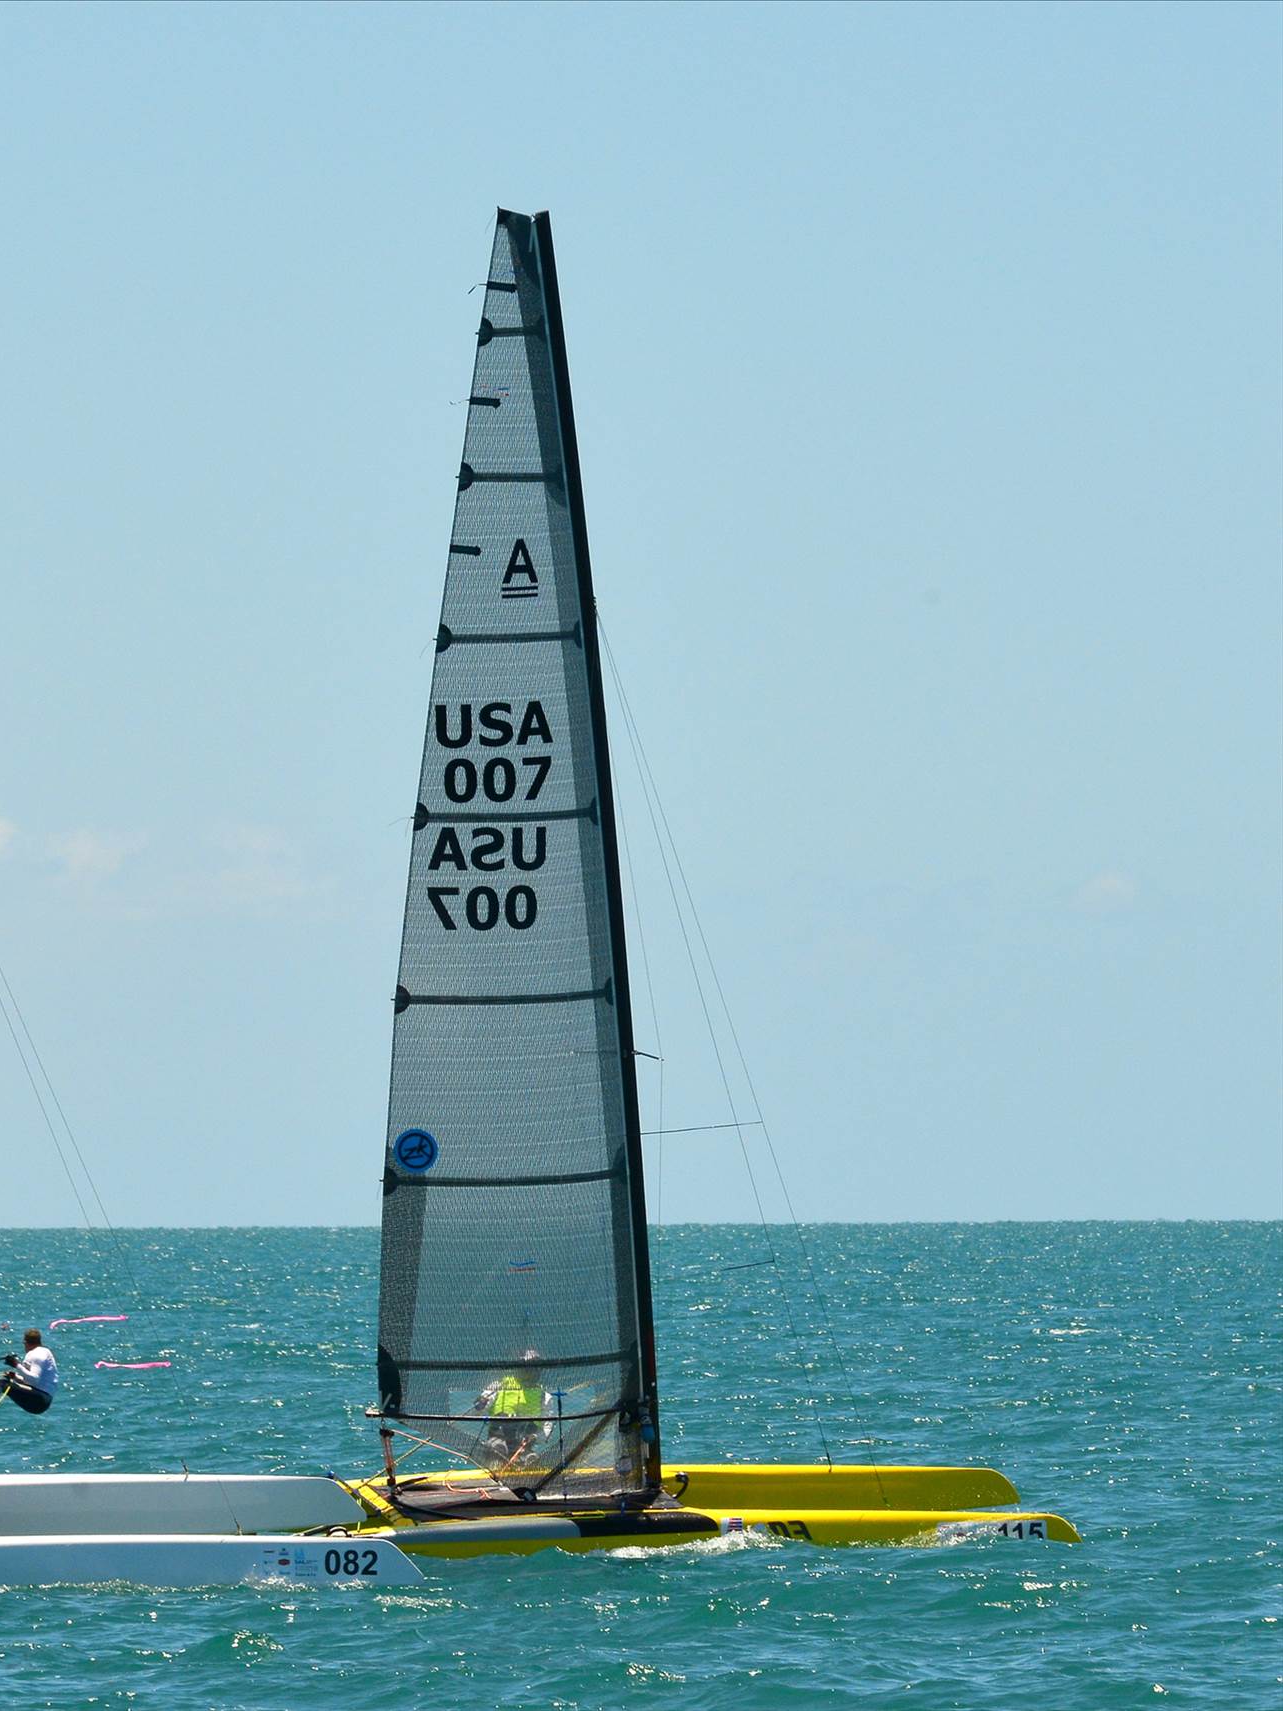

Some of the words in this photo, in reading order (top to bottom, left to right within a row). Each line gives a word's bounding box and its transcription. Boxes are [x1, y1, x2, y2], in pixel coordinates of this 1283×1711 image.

[501, 538, 539, 585] A
[434, 700, 554, 749] USA
[443, 755, 552, 804] 007
[324, 1549, 379, 1576] 082
